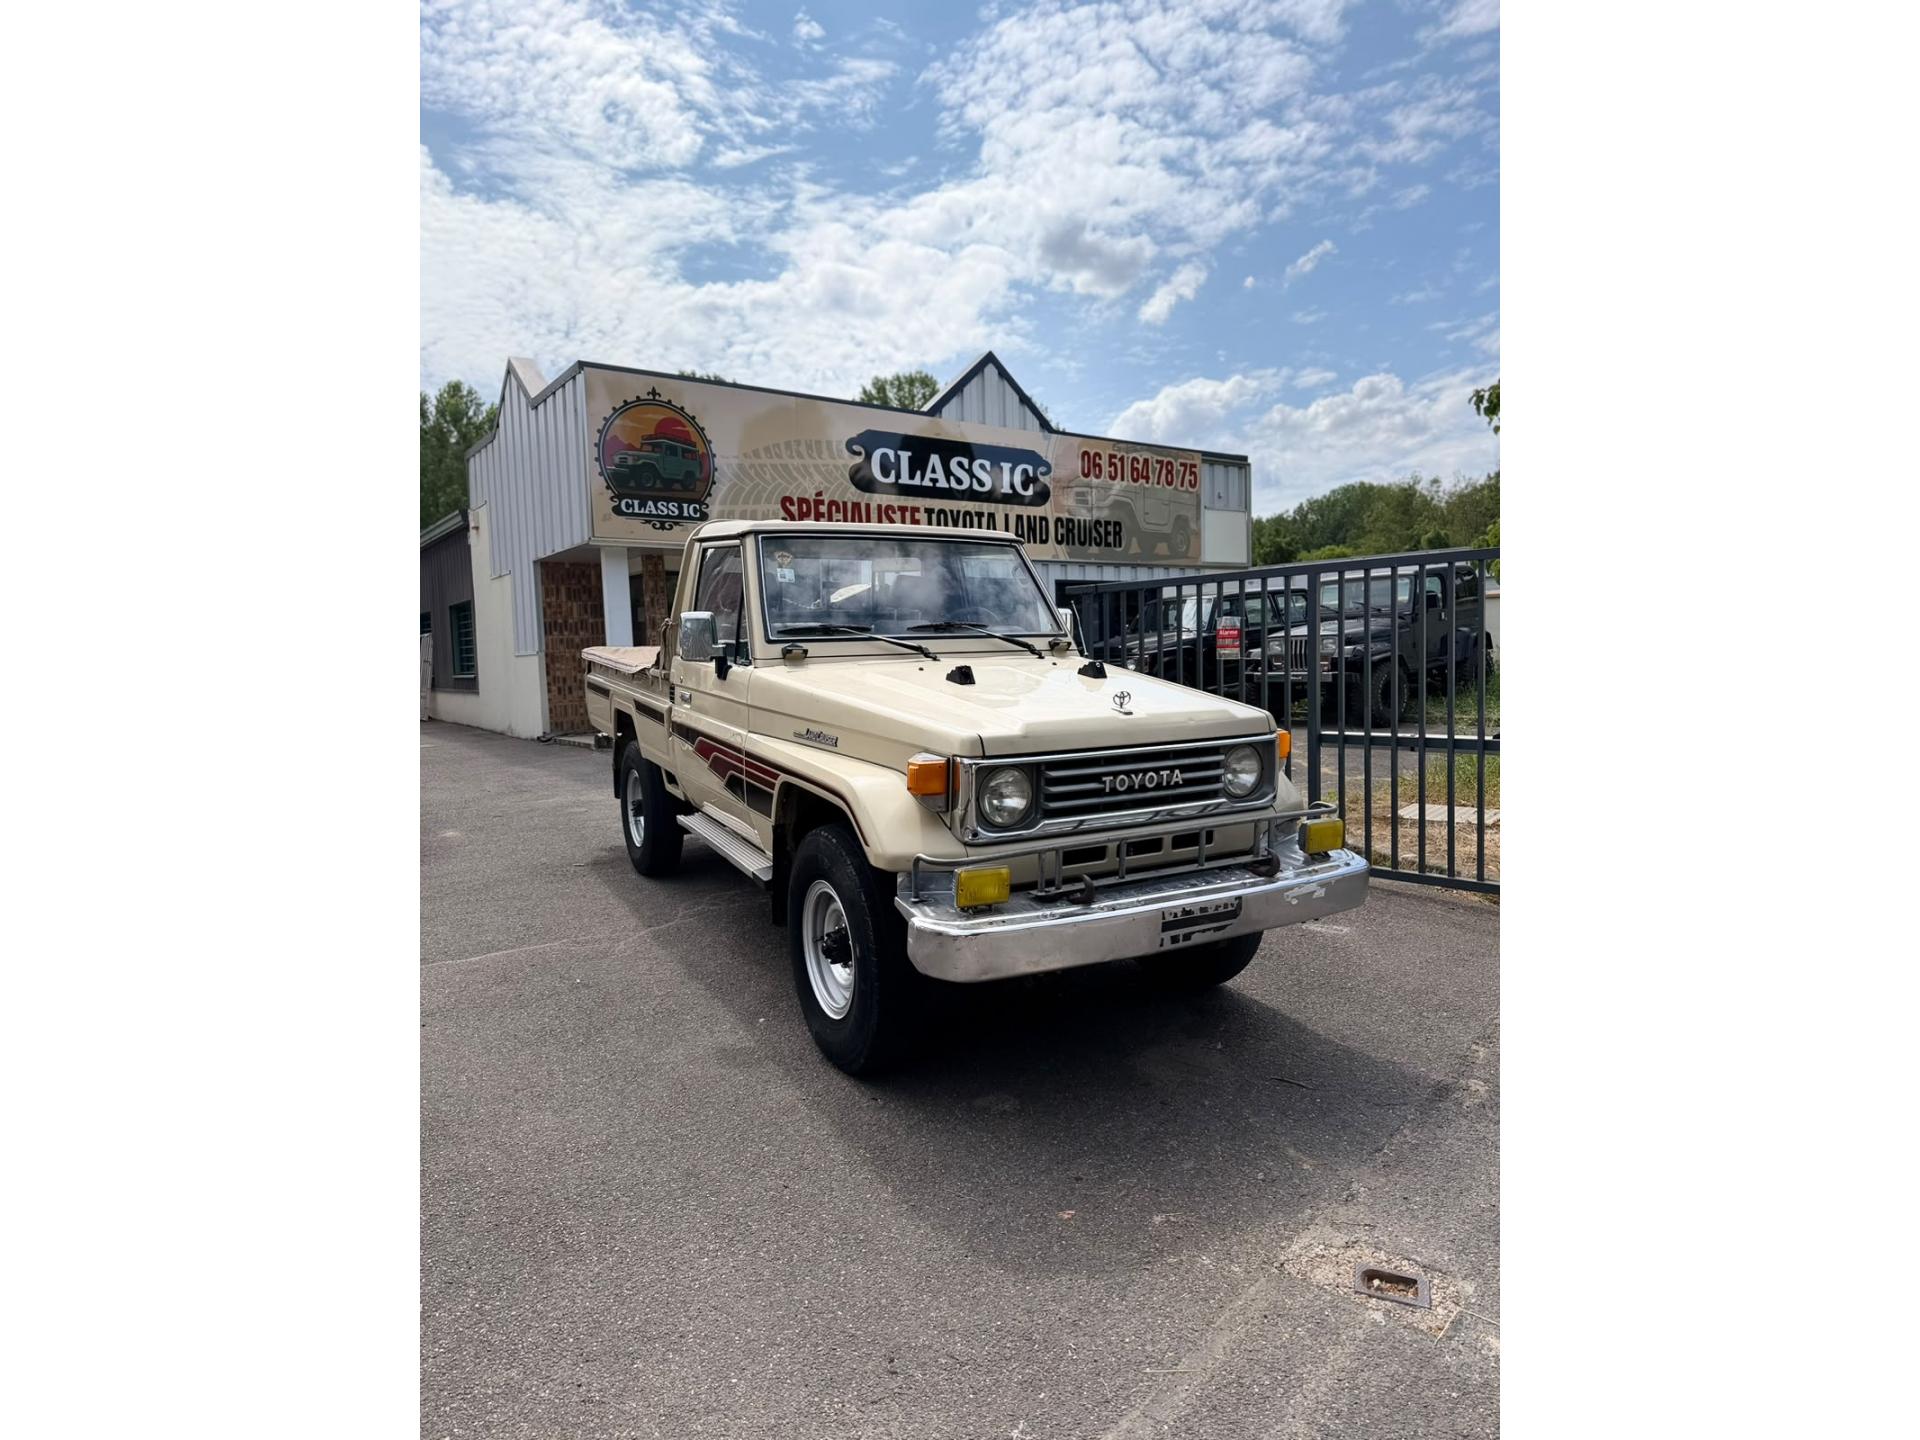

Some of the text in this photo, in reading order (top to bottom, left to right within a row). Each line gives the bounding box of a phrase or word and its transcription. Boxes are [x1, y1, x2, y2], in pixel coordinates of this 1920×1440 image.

[871, 448, 1034, 496] CLASS IC
[1080, 450, 1198, 489] 06 51 64 78 75
[621, 498, 700, 517] CLASS IC
[780, 490, 1122, 548] SPÉCIALISTE TOYOTA LAND CRUISER
[1102, 769, 1183, 793] TOYOTA
